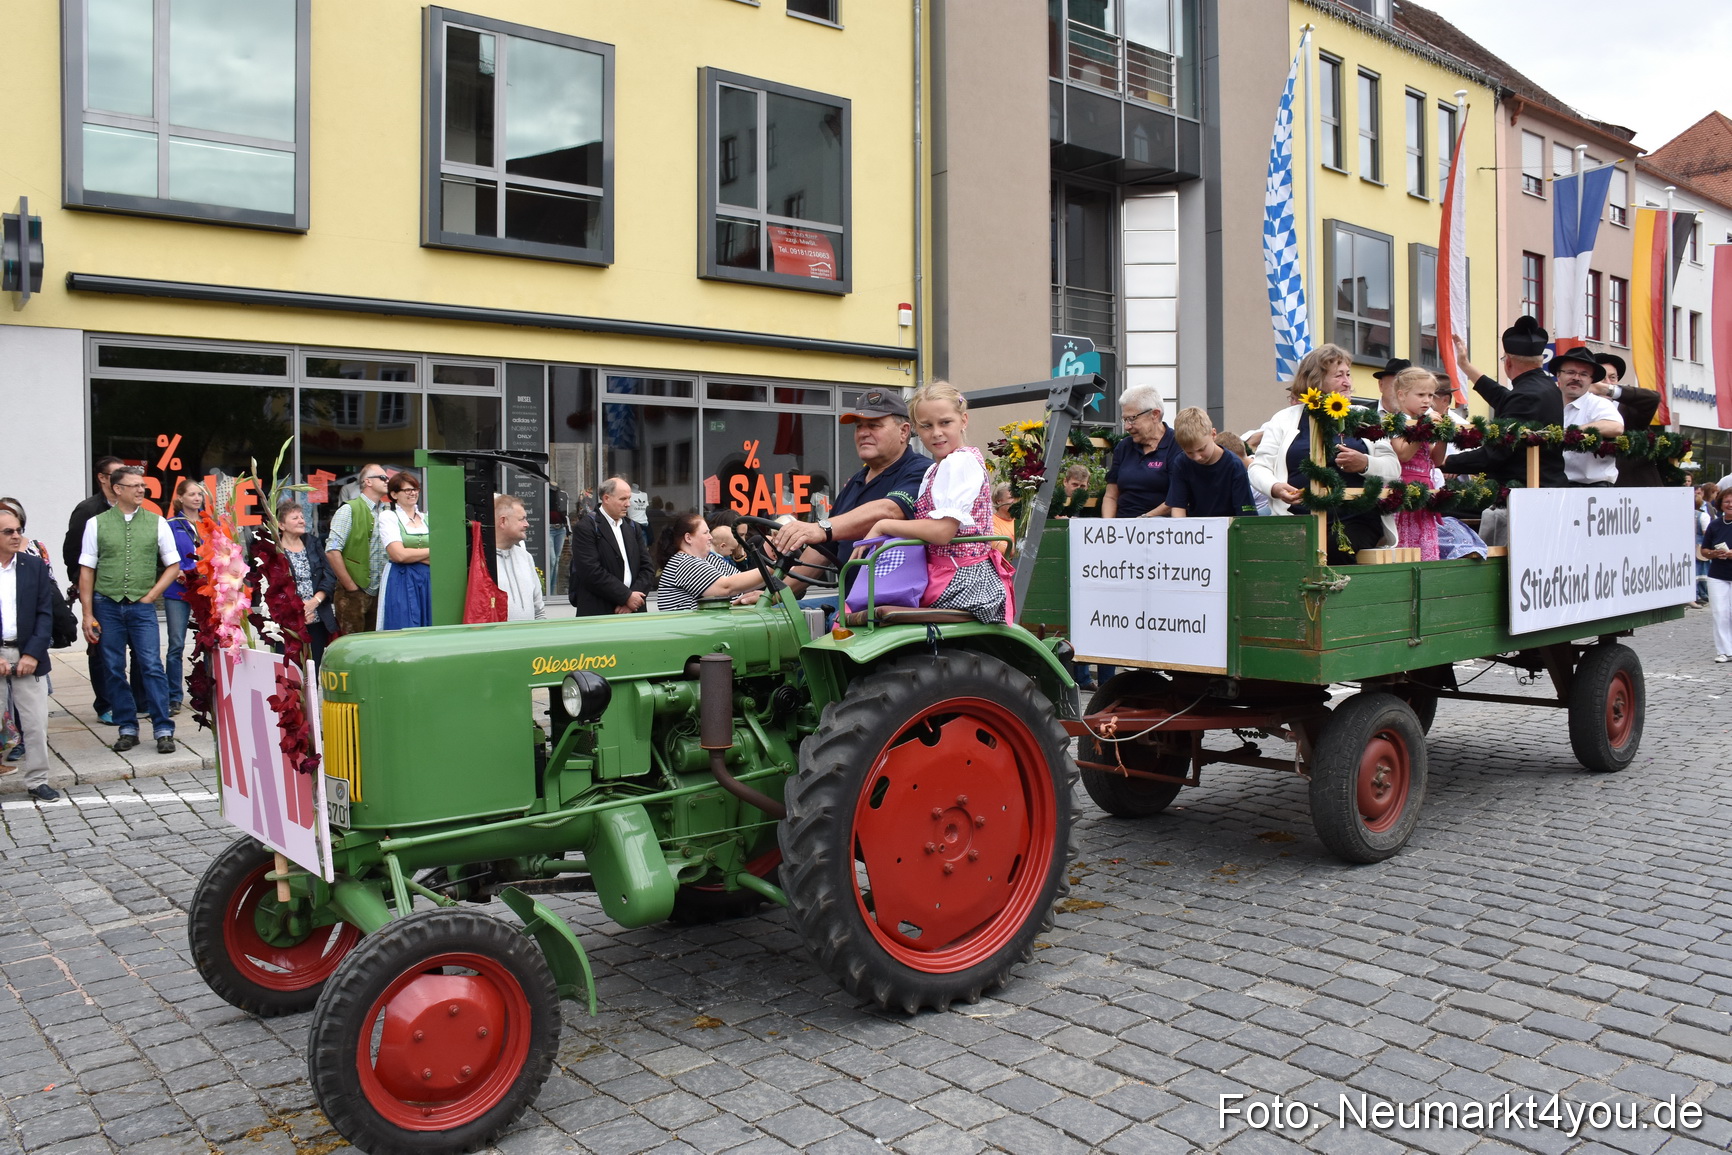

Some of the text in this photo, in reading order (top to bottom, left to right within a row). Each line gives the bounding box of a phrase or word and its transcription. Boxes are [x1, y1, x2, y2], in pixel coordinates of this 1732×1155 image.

[1672, 384, 1717, 408] uchhandlung
[729, 472, 812, 517] SALE
[1587, 496, 1641, 538] Familie
[1083, 525, 1213, 545] KAB-Vorstand-
[1082, 559, 1211, 588] schaftssitzung
[1519, 553, 1692, 612] Stiefkind der Gesellschaft
[1090, 609, 1206, 634] Anno dazumal
[531, 653, 617, 676] Dieselross
